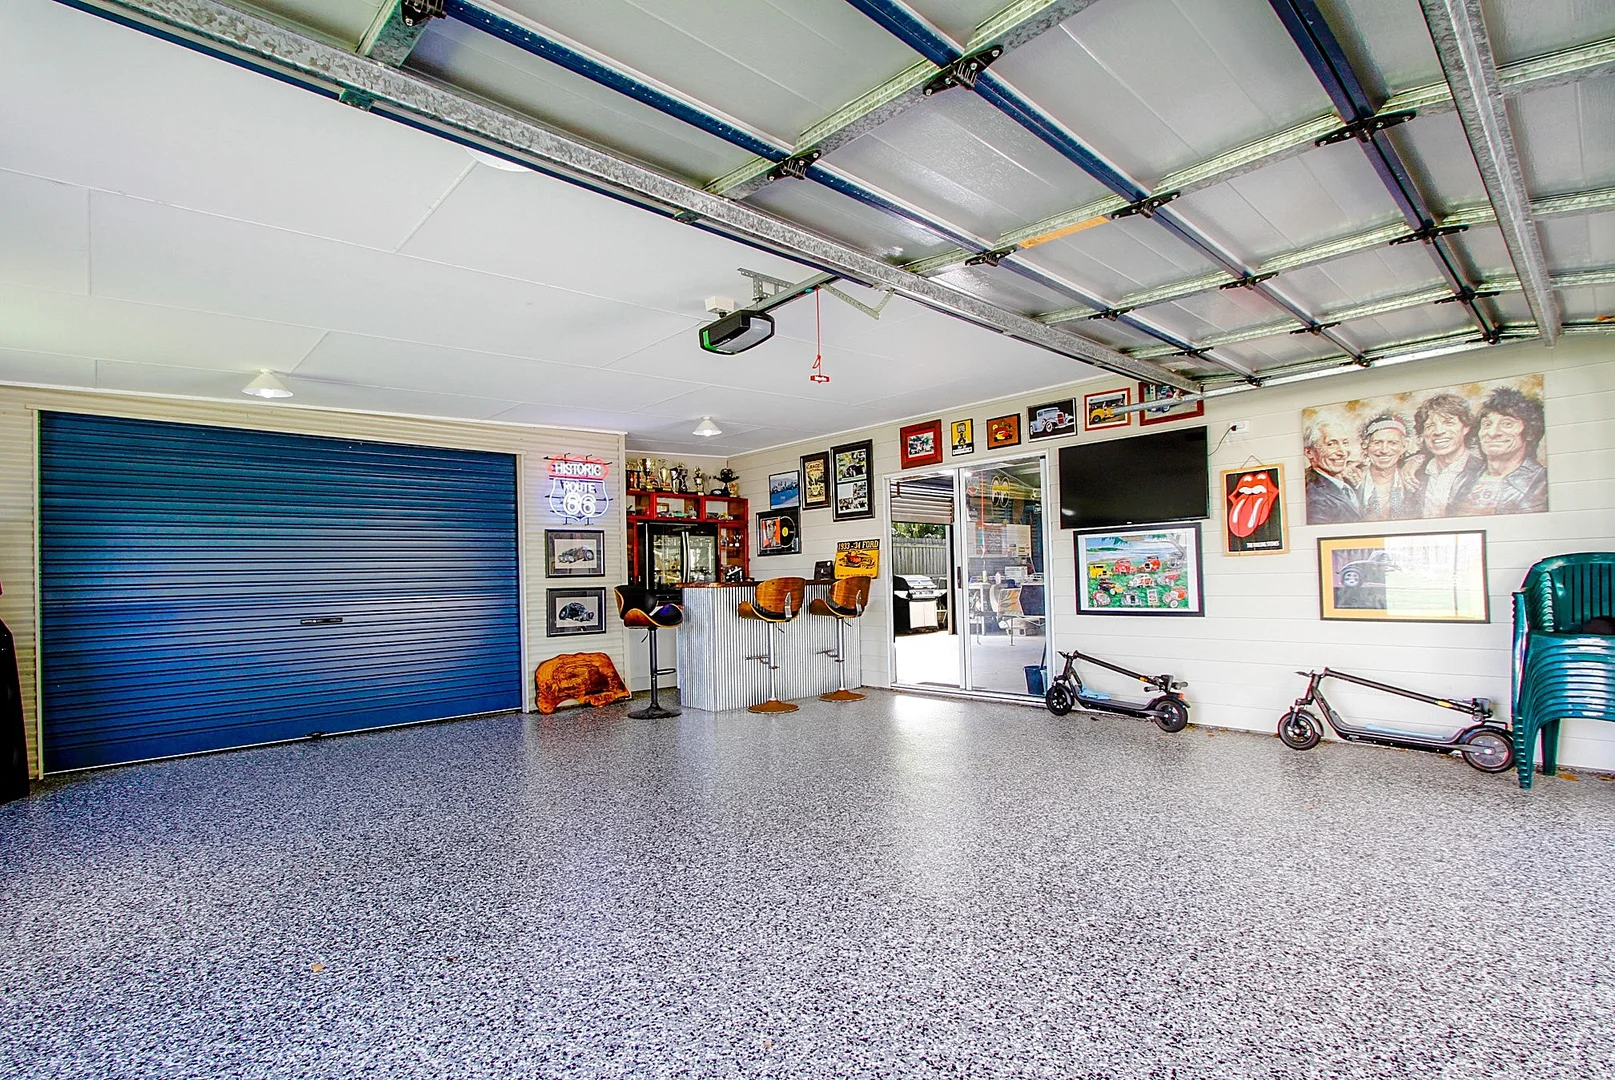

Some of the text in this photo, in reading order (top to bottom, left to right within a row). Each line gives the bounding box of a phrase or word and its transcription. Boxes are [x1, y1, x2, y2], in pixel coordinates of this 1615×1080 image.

[555, 463, 601, 476] HISTORIC
[564, 481, 596, 493] ROUTE
[564, 493, 596, 516] 66
[862, 540, 879, 549] FORD
